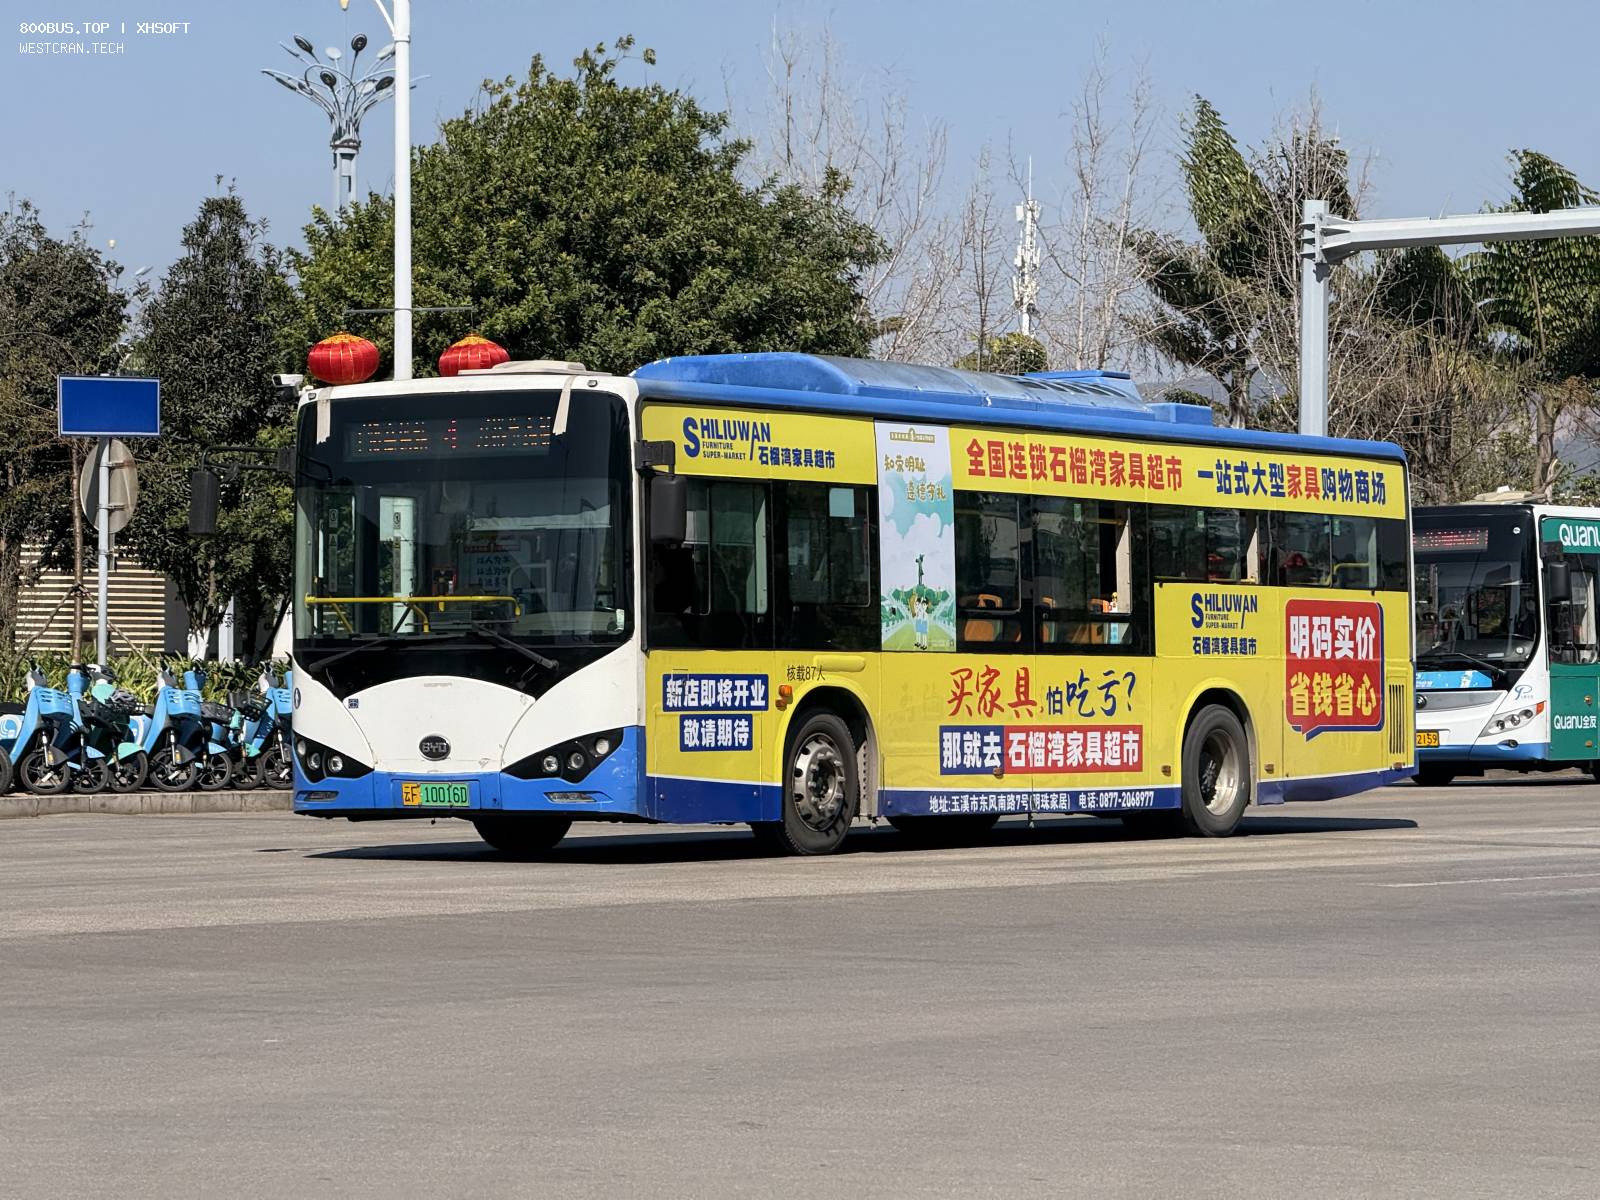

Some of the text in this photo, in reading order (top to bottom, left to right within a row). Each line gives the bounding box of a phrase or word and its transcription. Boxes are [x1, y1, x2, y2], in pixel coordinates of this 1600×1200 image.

[683, 416, 771, 461] SHILIUWAN
[702, 441, 734, 450] FURNITURE
[703, 450, 746, 460] SUPER-MARKET
[758, 446, 835, 469] 石榴湾家具超市
[966, 438, 1387, 505] 全国连锁石榴湾家具超市 一站式大型家具购物商场
[1191, 592, 1258, 629] SHILIUWAN
[1192, 636, 1257, 656] 石榴湾家具超市
[1289, 615, 1376, 660] 明码实价
[787, 664, 826, 682] 核载87人
[666, 678, 766, 708] 新店即将开业
[1290, 671, 1377, 717] 省钱省心
[683, 718, 750, 748] 敬请期待
[421, 742, 447, 753] BYD
[403, 785, 468, 803] 云F 10016D
